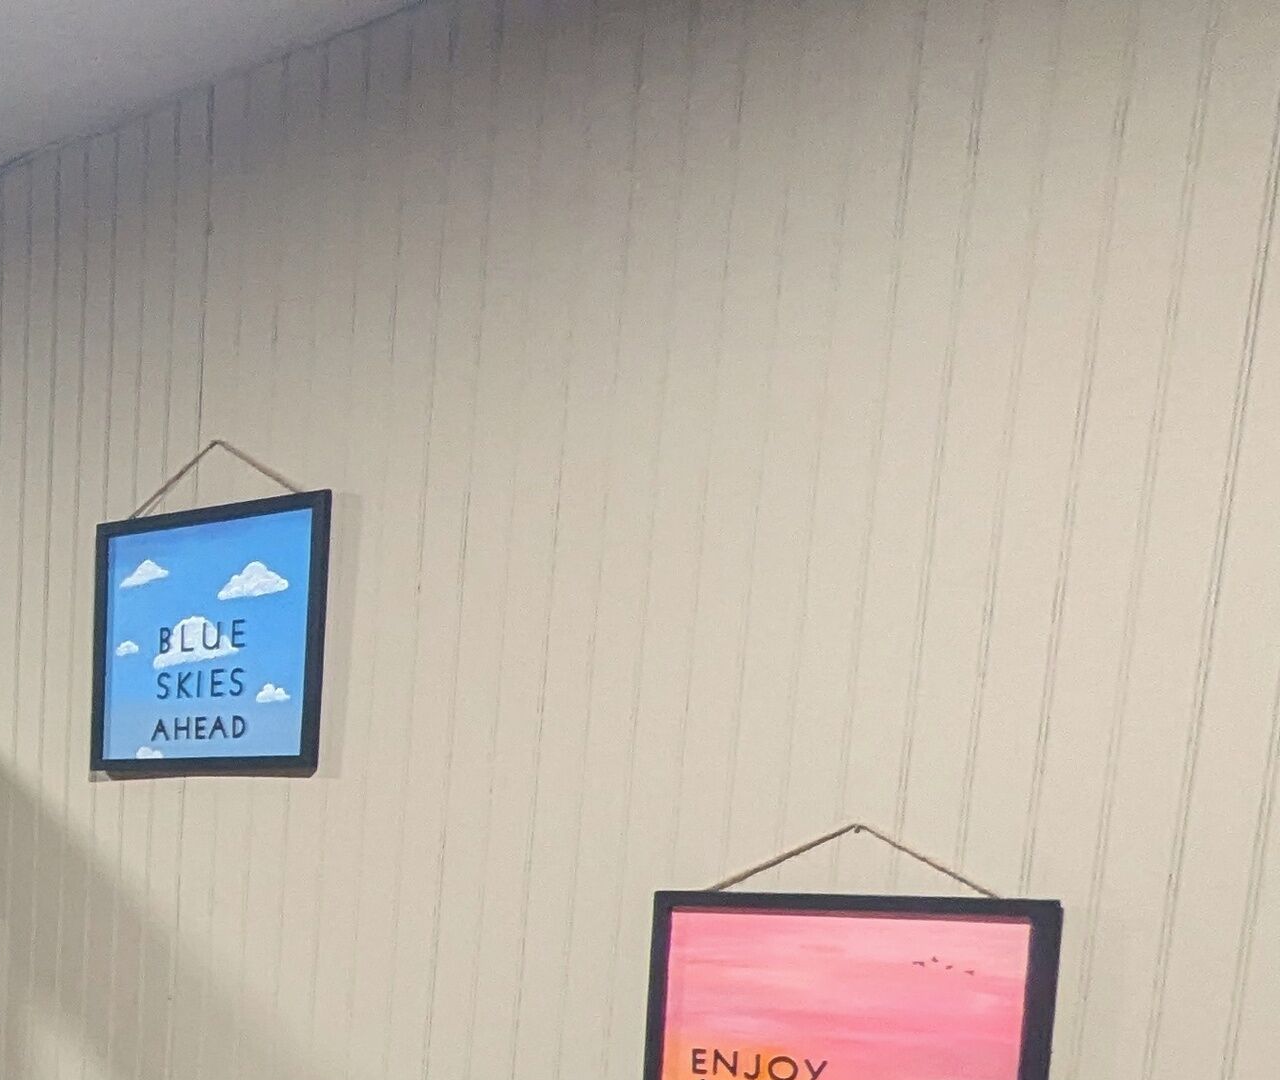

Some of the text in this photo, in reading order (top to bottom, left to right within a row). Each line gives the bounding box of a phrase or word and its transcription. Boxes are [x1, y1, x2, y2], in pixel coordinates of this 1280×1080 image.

[159, 619, 246, 654] BLUE
[156, 667, 246, 700] SKIES
[151, 715, 247, 742] AHEAD
